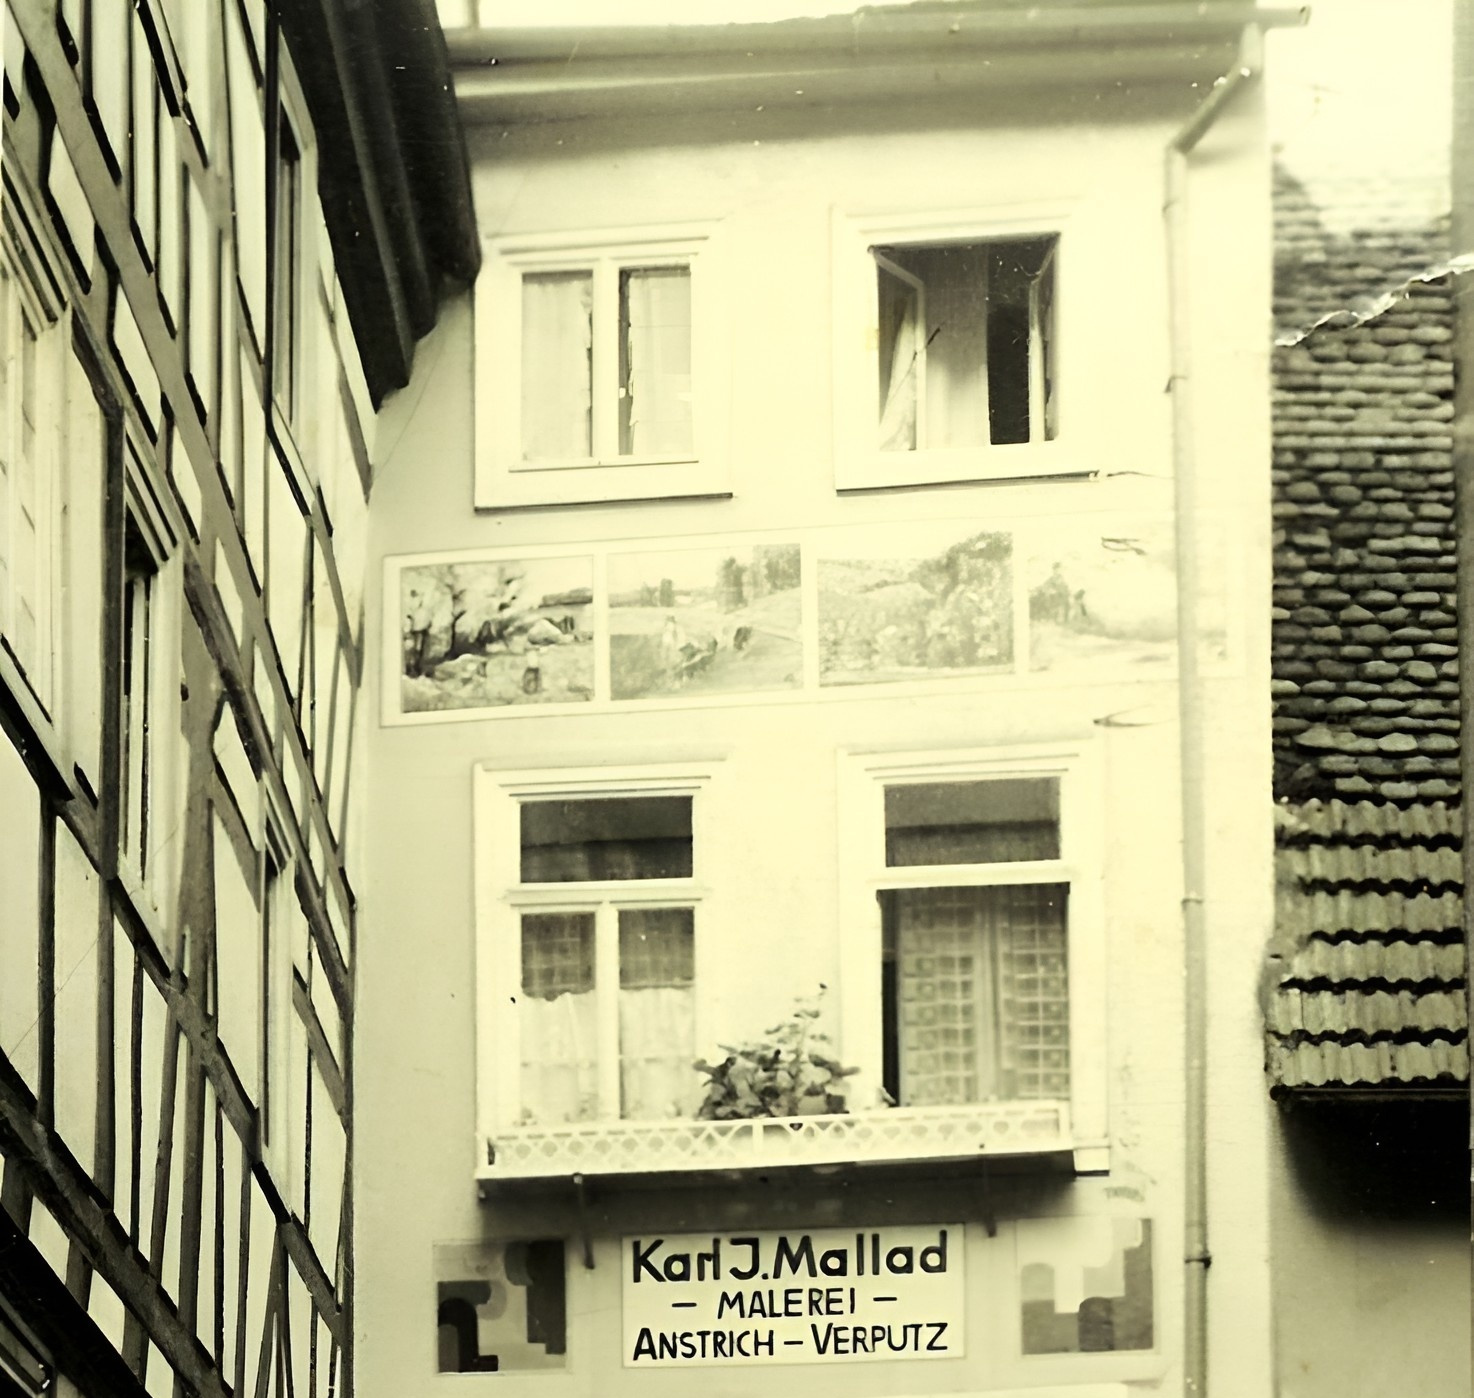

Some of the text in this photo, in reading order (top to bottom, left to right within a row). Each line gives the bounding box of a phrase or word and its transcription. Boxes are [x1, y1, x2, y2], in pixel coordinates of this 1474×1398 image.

[632, 1237, 721, 1284] Karl
[717, 1287, 856, 1320] MALEREI
[632, 1327, 774, 1361] ANSTRICH
[811, 1322, 949, 1355] VERPUTZ
